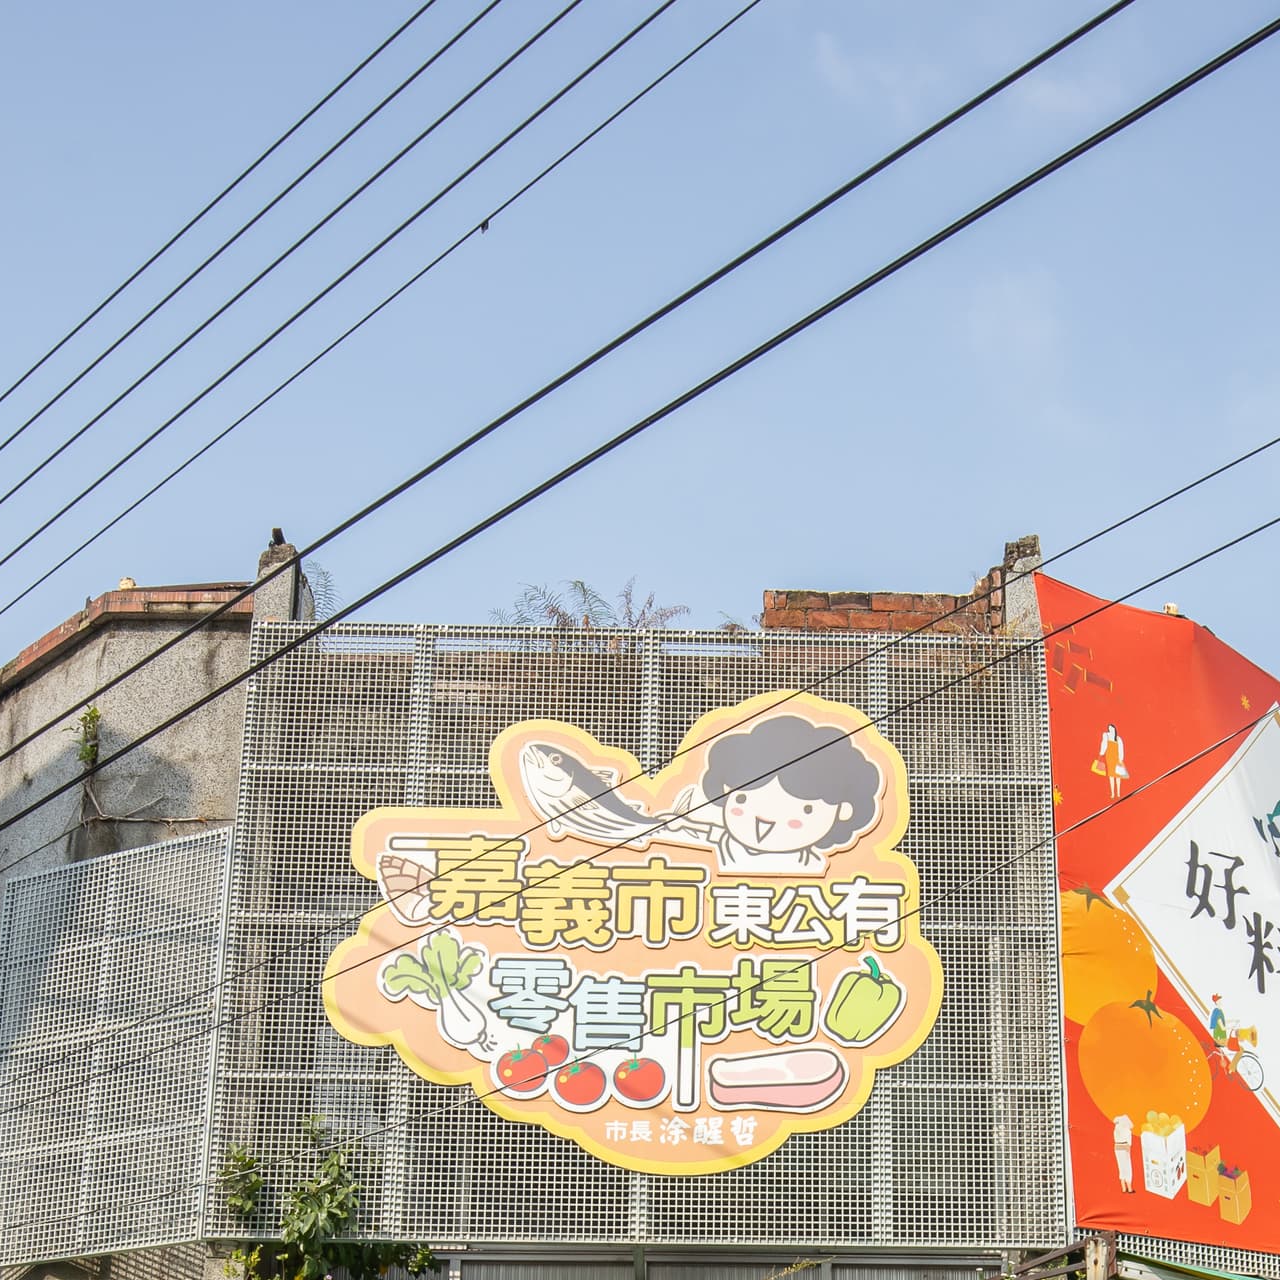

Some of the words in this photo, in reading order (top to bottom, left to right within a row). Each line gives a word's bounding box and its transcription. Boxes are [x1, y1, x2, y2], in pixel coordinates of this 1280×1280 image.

[390, 836, 708, 947] 嘉義市
[709, 877, 905, 946] 東公有
[488, 957, 819, 1107] 零售市場
[604, 1121, 652, 1143] 市長
[659, 1116, 757, 1147] 涂醒哲
